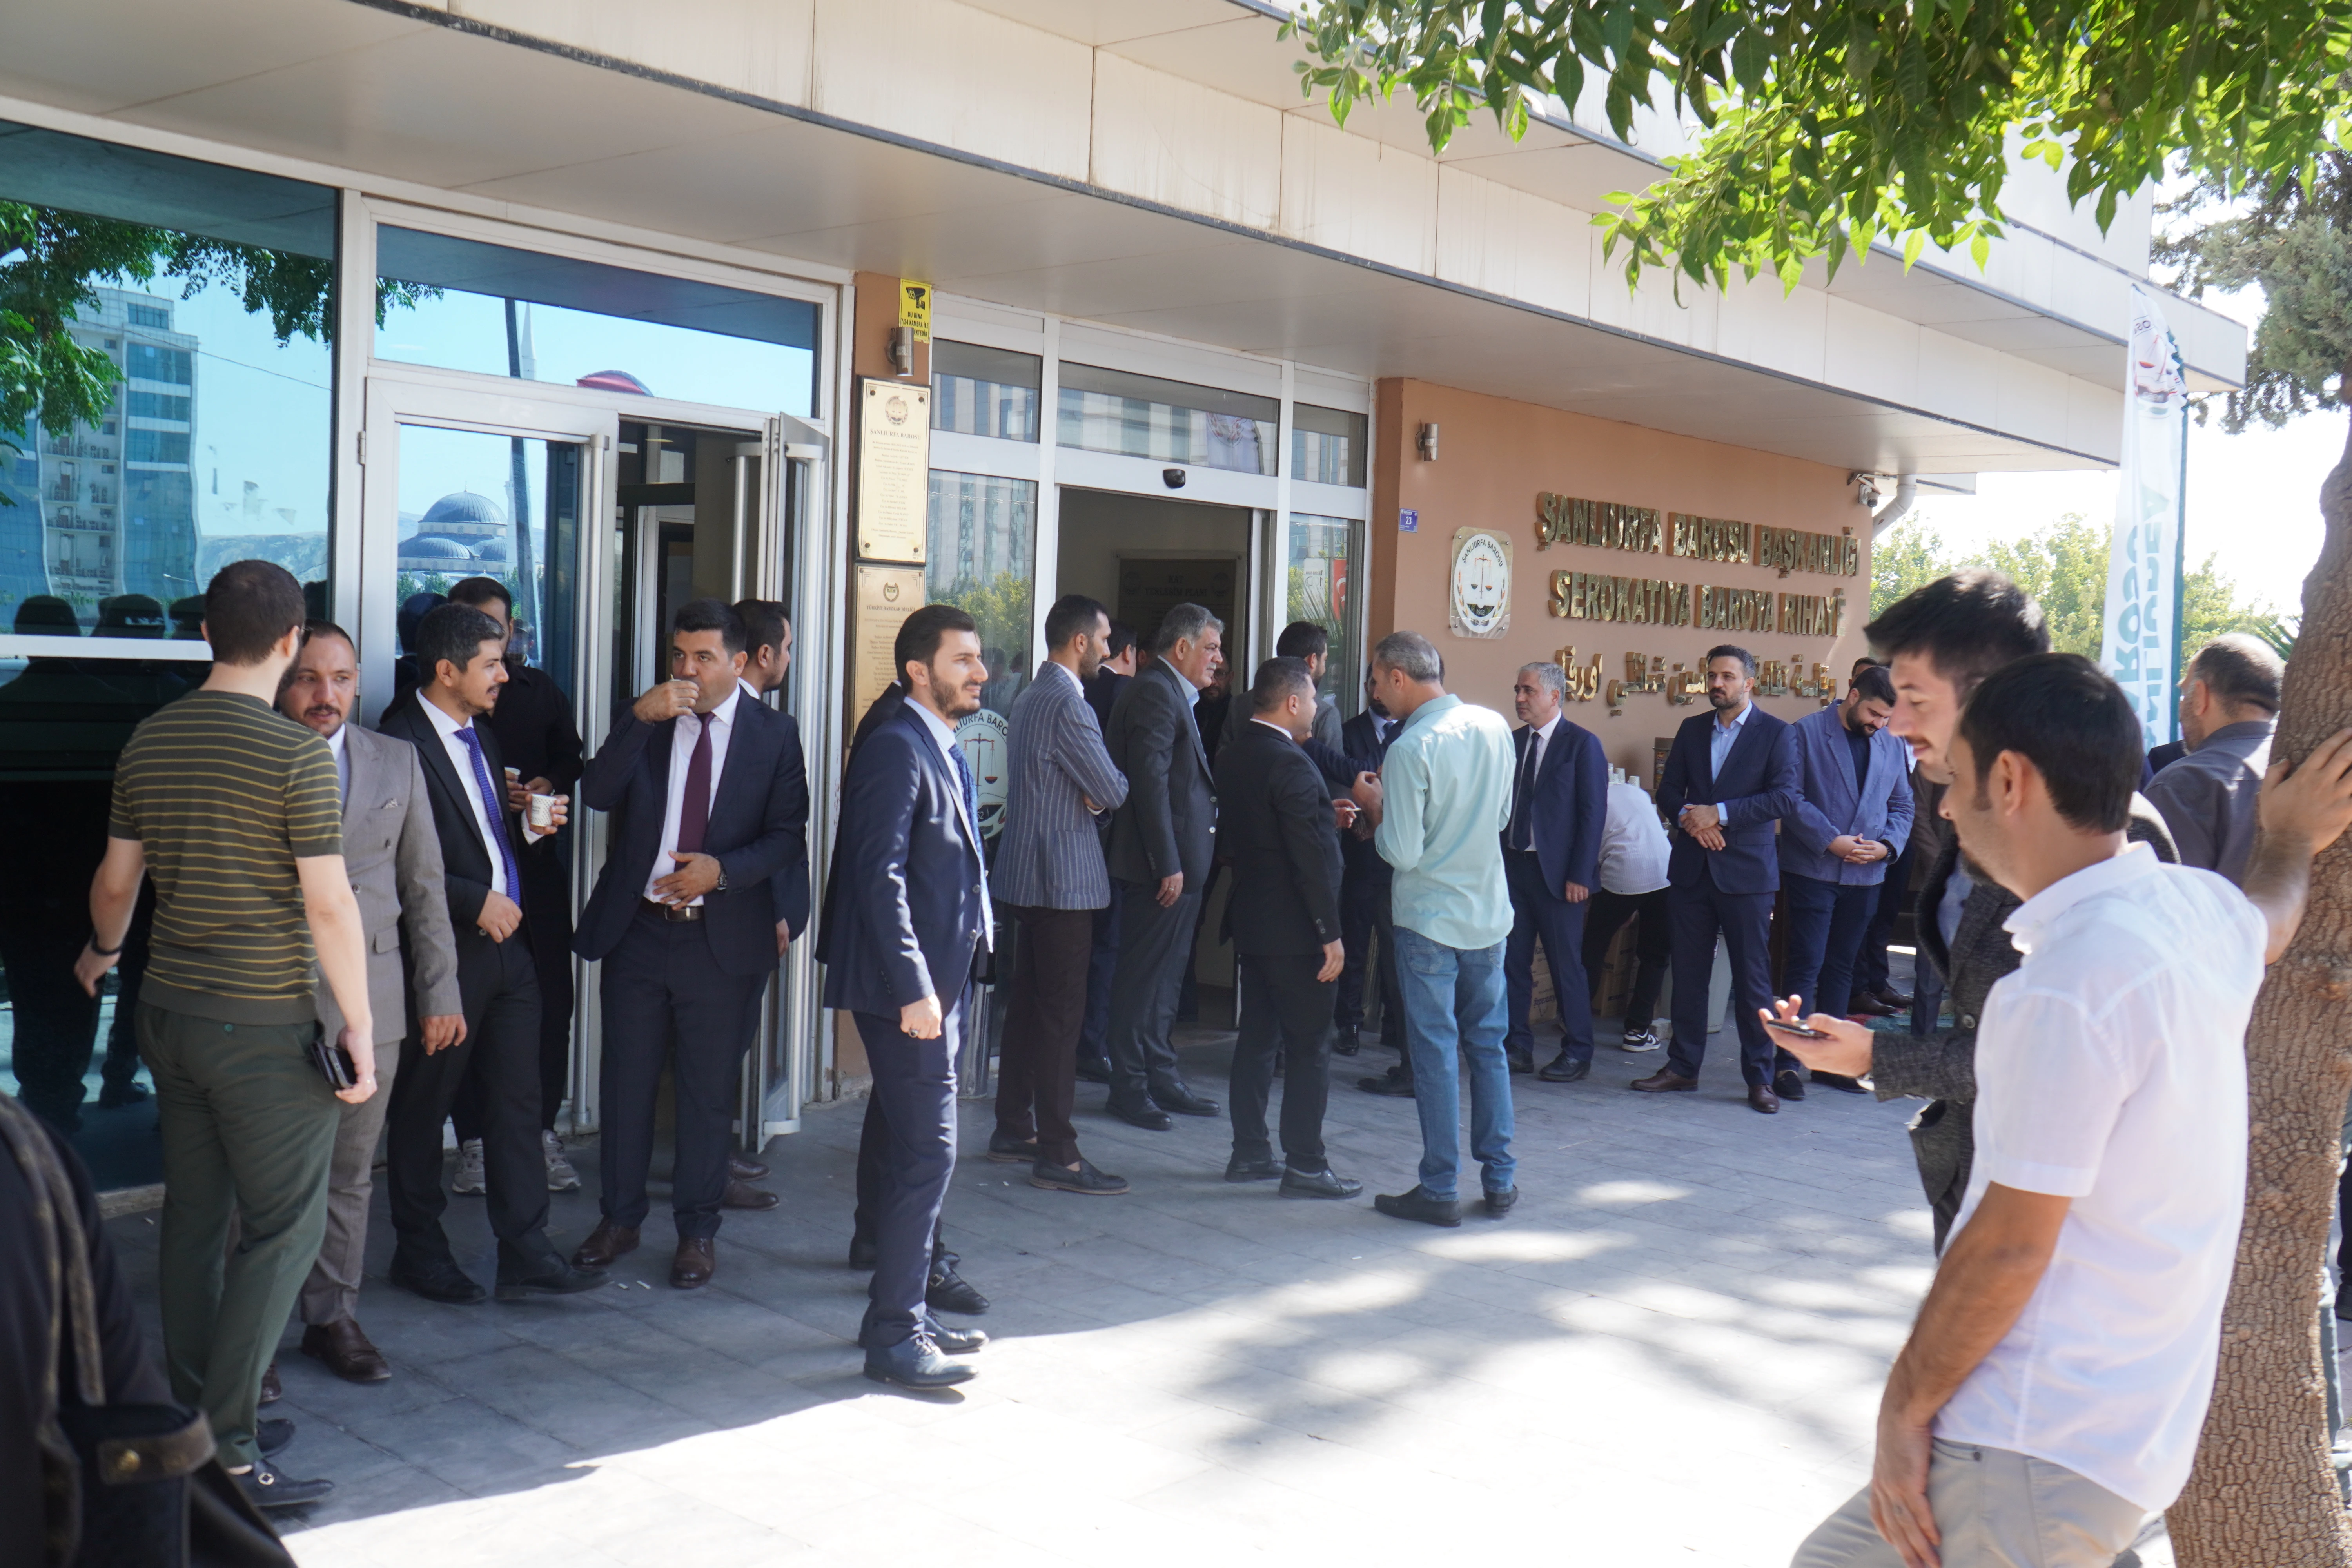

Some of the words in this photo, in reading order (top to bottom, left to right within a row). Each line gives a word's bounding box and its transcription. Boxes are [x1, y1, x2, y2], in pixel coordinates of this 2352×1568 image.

[870, 428, 899, 438] ŞANLIURFA
[900, 432, 921, 441] BAROSU
[1405, 516, 1412, 525] 23
[1535, 491, 1663, 551] ŞANLIURFA
[1667, 512, 1751, 564] BAROSU
[1754, 524, 1861, 578] BAŞKANLIĞI
[1462, 539, 1486, 564] ŞANLIURFA
[1487, 541, 1503, 567] BAROSU
[1548, 570, 1691, 626] SEROKATIYA
[1694, 584, 1773, 632] BAROYA
[953, 712, 984, 733] LIURFA
[987, 713, 1008, 736] BARO
